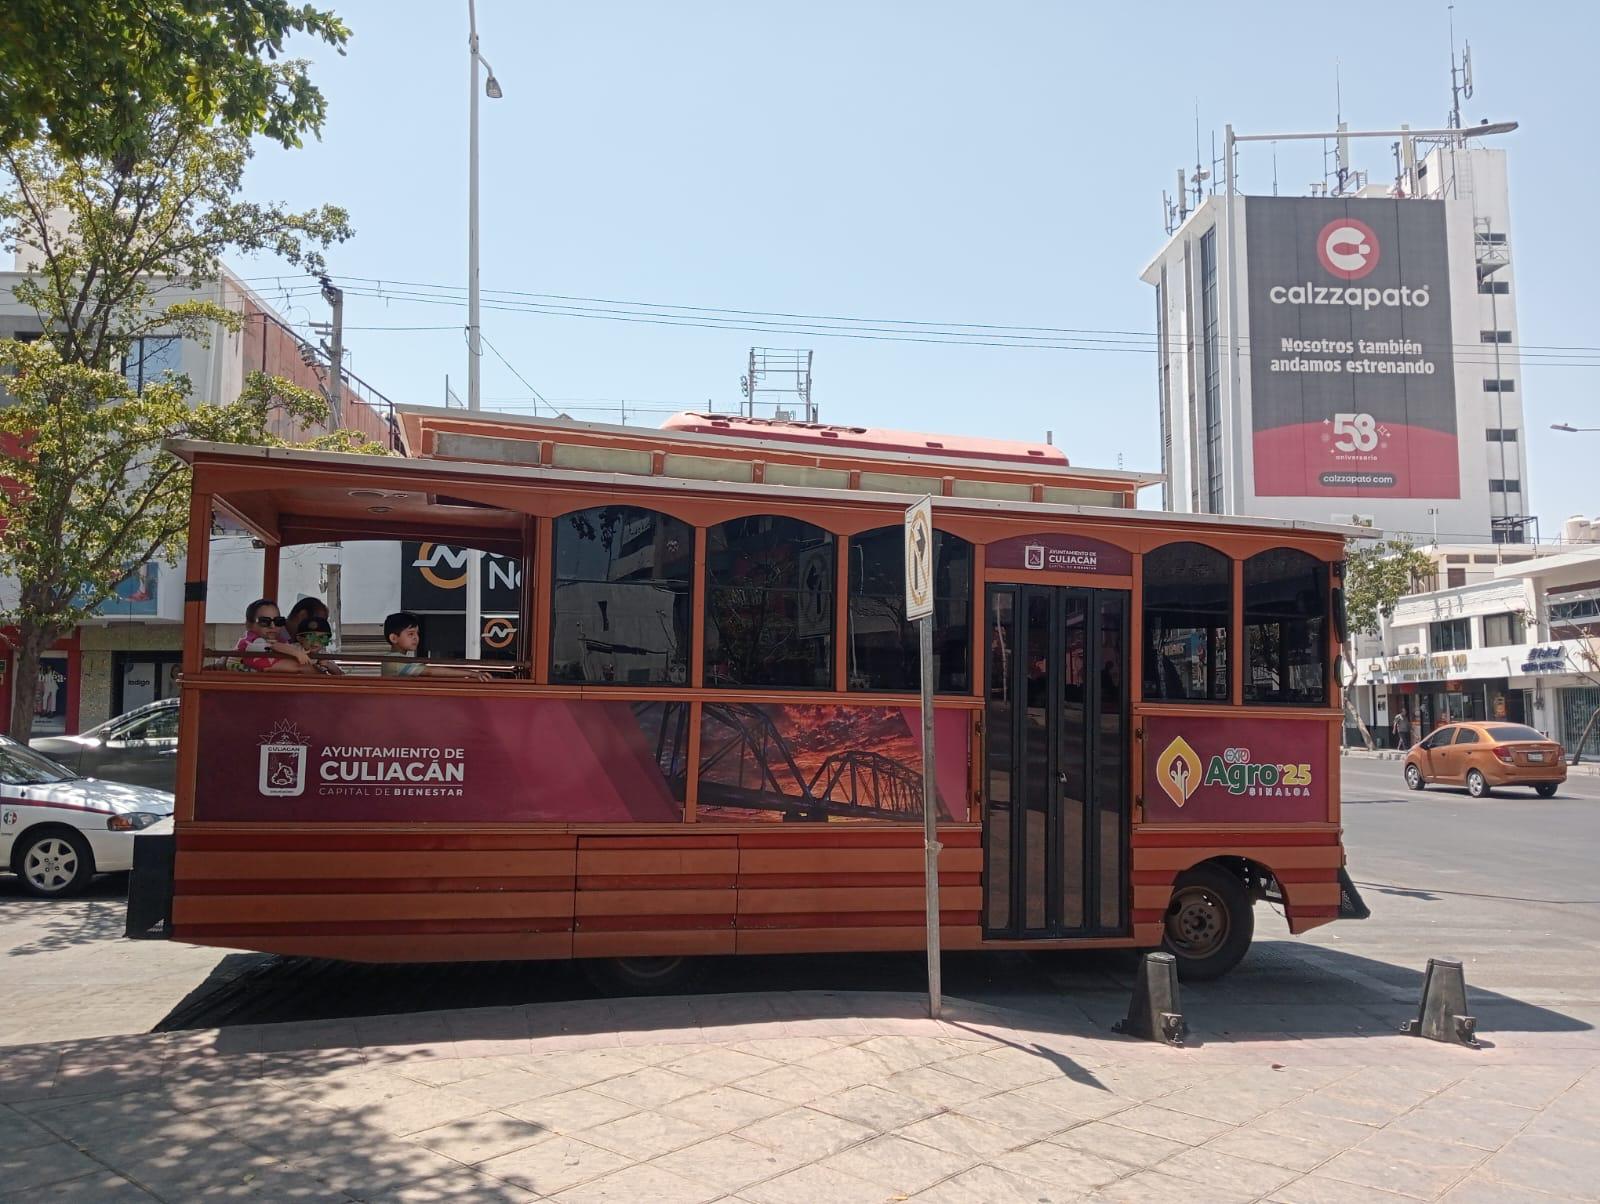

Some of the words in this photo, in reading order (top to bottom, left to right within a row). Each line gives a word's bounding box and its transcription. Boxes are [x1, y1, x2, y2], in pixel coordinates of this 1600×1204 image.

[1269, 281, 1430, 311] calzzapato
[1281, 337, 1354, 355] Nosotros
[1359, 338, 1423, 356] también
[1270, 357, 1342, 373] andamos
[1346, 358, 1435, 375] estrenando
[1333, 413, 1379, 453] 58
[320, 746, 441, 760] AYUNTAMIENTO
[444, 748, 465, 760] DE
[319, 759, 465, 782] CULIACÁN
[318, 786, 371, 797] CAPITAL
[375, 788, 391, 797] DE
[393, 787, 464, 797] BIENESTAR
[1248, 787, 1311, 797] SINALOA
